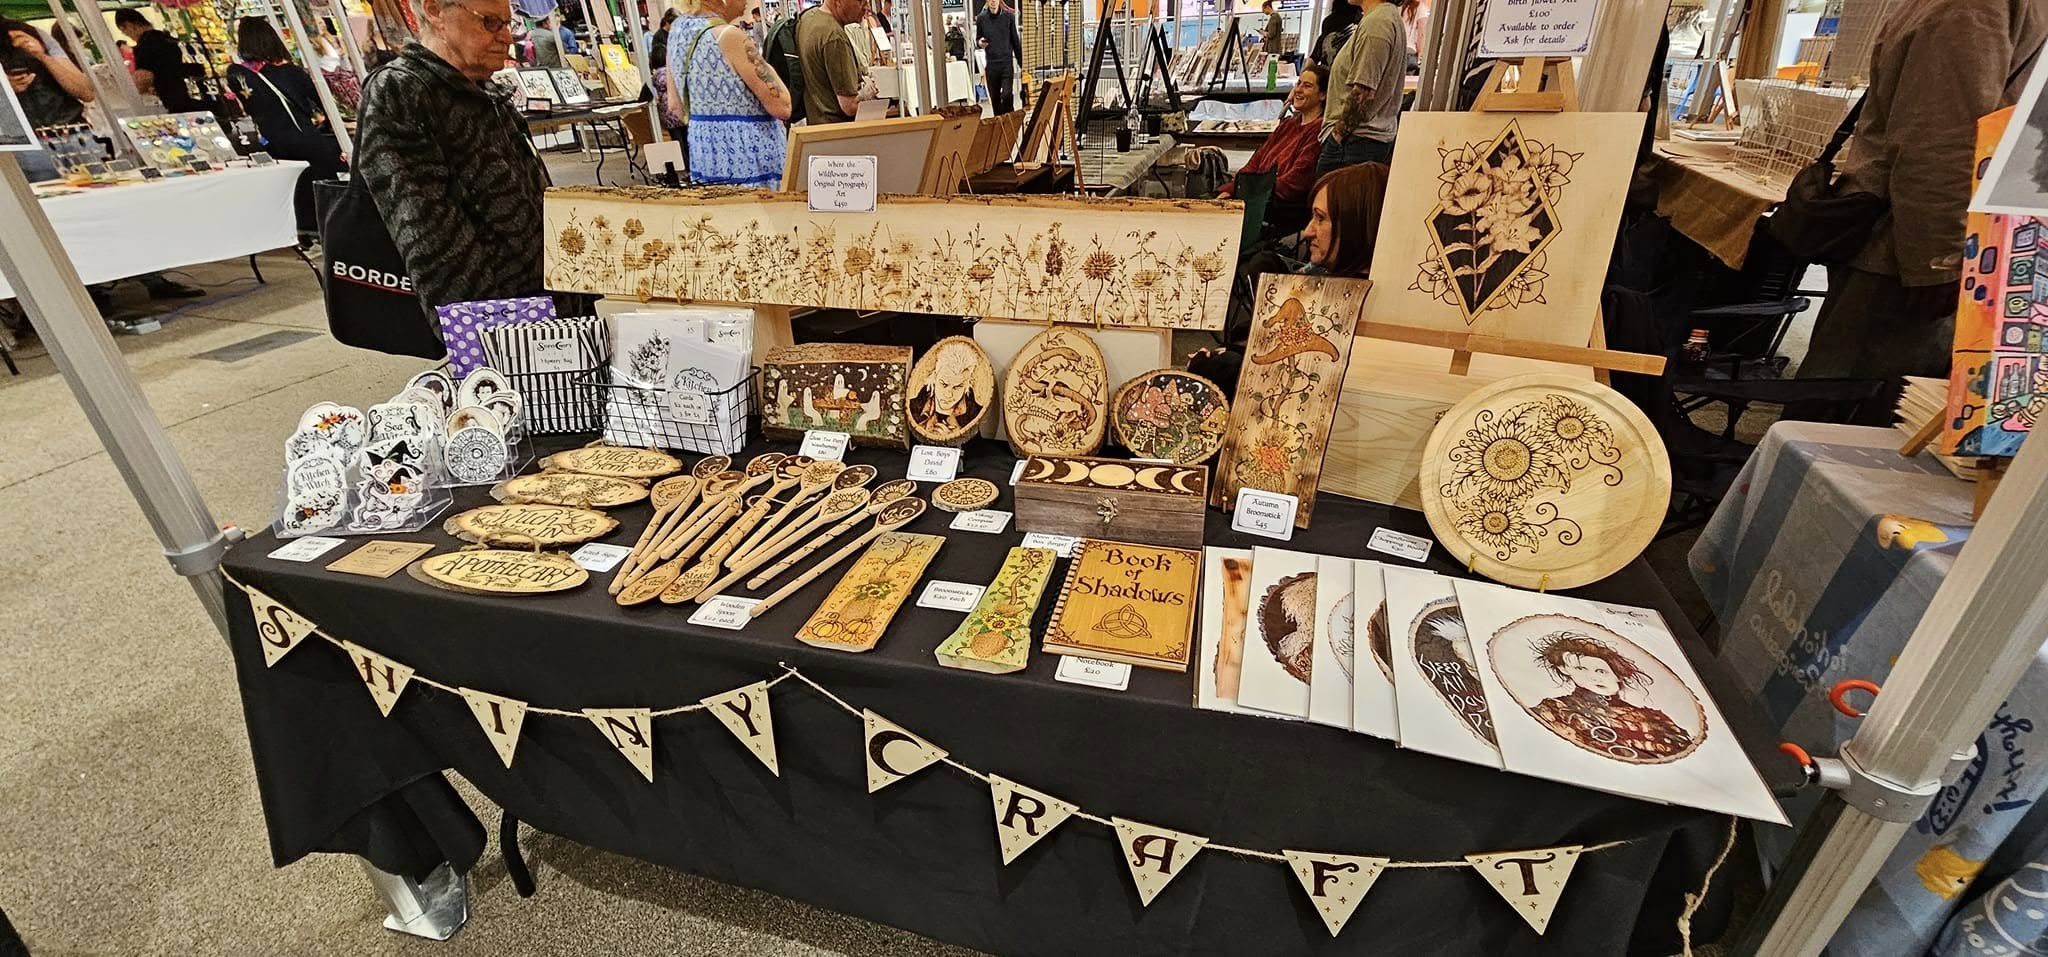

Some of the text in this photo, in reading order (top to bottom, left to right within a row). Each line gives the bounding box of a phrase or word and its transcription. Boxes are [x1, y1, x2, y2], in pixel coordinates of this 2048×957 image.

[1499, 22, 1576, 32] Available to order
[1503, 35, 1566, 46] Ask for details
[828, 160, 856, 168] Where the
[838, 181, 868, 189] Pyrography
[384, 422, 403, 432] Sea
[937, 450, 950, 458] Boys
[299, 469, 330, 481] Kitchen
[1252, 498, 1280, 509] Autumn
[1246, 508, 1281, 520] Broomstick
[1101, 549, 1172, 571] Book
[1125, 569, 1143, 580] of
[1072, 576, 1184, 606] Shadows
[1442, 675, 1468, 693] All
[1448, 694, 1487, 716] Day
